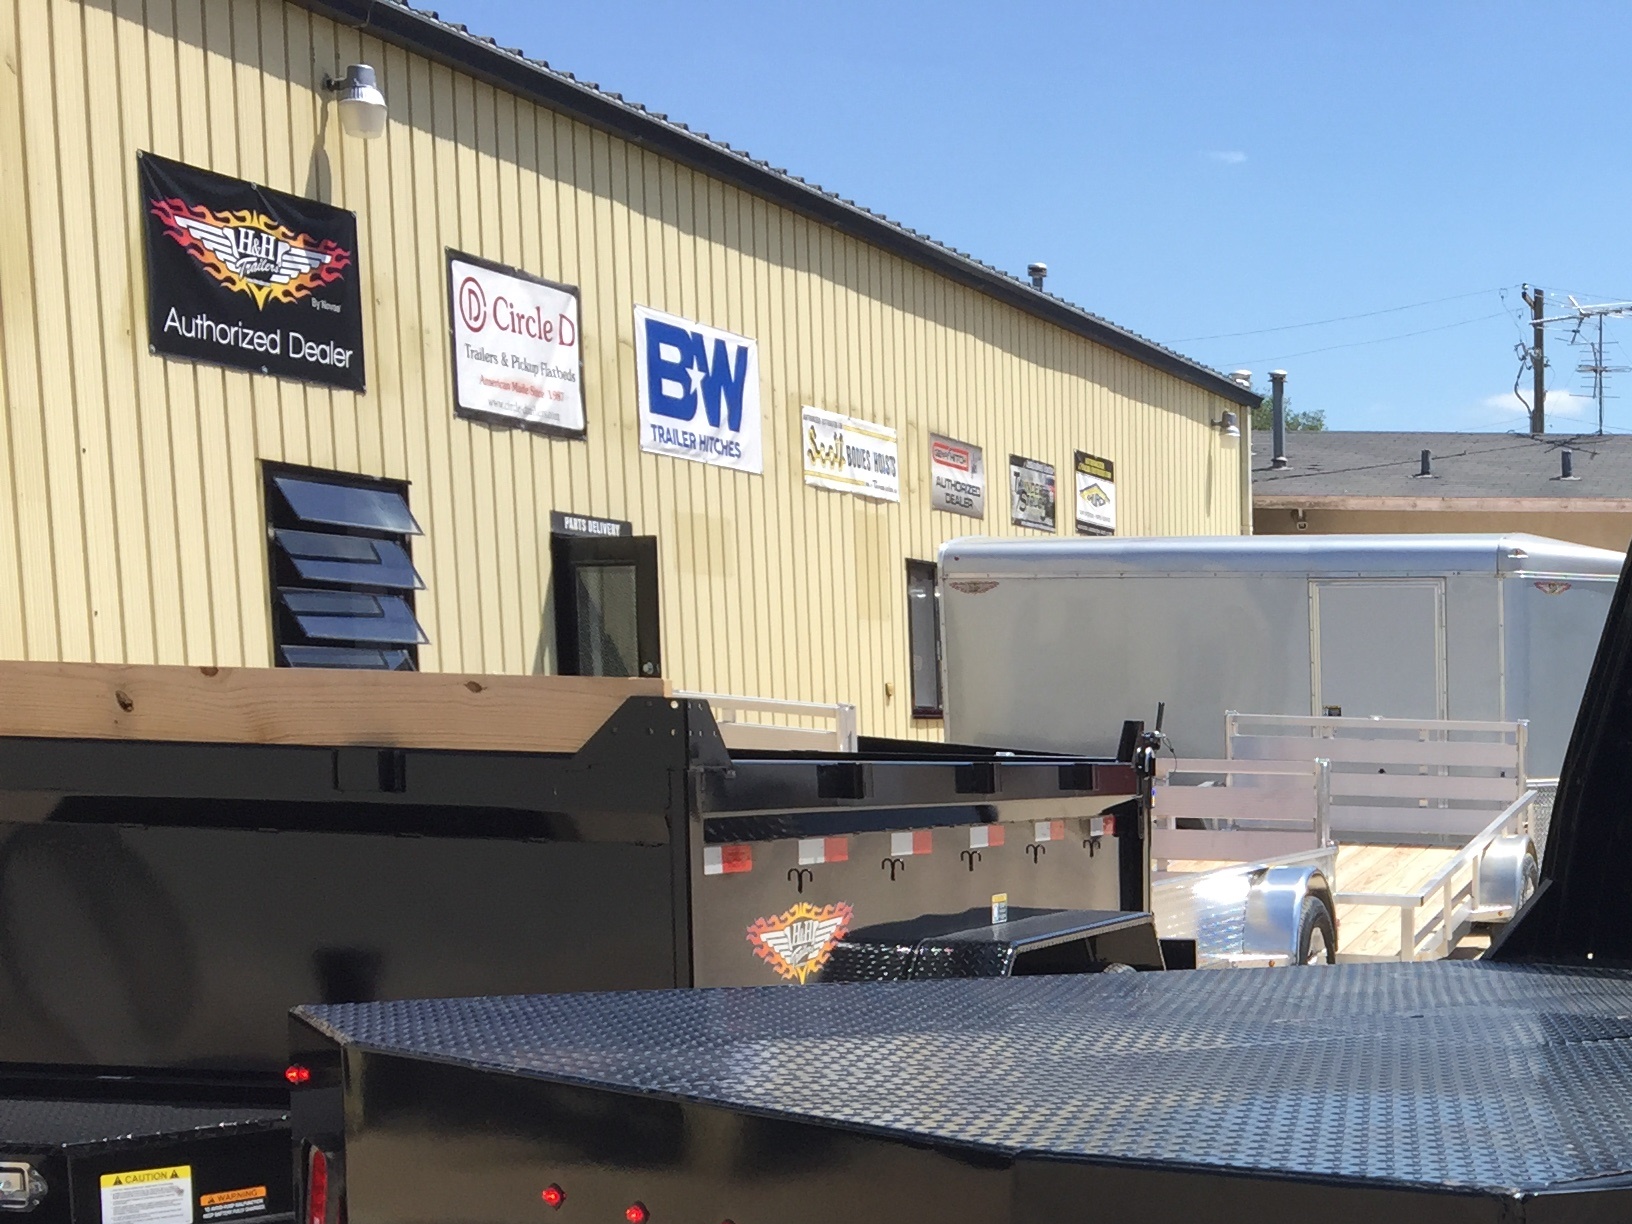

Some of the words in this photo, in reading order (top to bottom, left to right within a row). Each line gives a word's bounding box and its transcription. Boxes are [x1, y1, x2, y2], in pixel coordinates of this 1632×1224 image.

[237, 227, 276, 261] H&H
[236, 258, 280, 279] Trailers
[493, 296, 553, 342] Circle
[559, 314, 575, 346] D
[164, 307, 280, 355] Authorized
[289, 332, 353, 368] Dealer
[464, 343, 498, 366] Trailers
[501, 352, 509, 367] &
[511, 354, 539, 377] Pickup
[650, 424, 697, 450] TRAILER
[698, 434, 741, 459] HITCHES
[936, 476, 981, 497] AUTHORIZED
[945, 493, 973, 509] DEALER
[564, 516, 587, 532] PARTS
[588, 520, 621, 536] DELIVERY
[125, 1171, 168, 1184] CAUTION
[217, 1189, 258, 1202] WARNING
